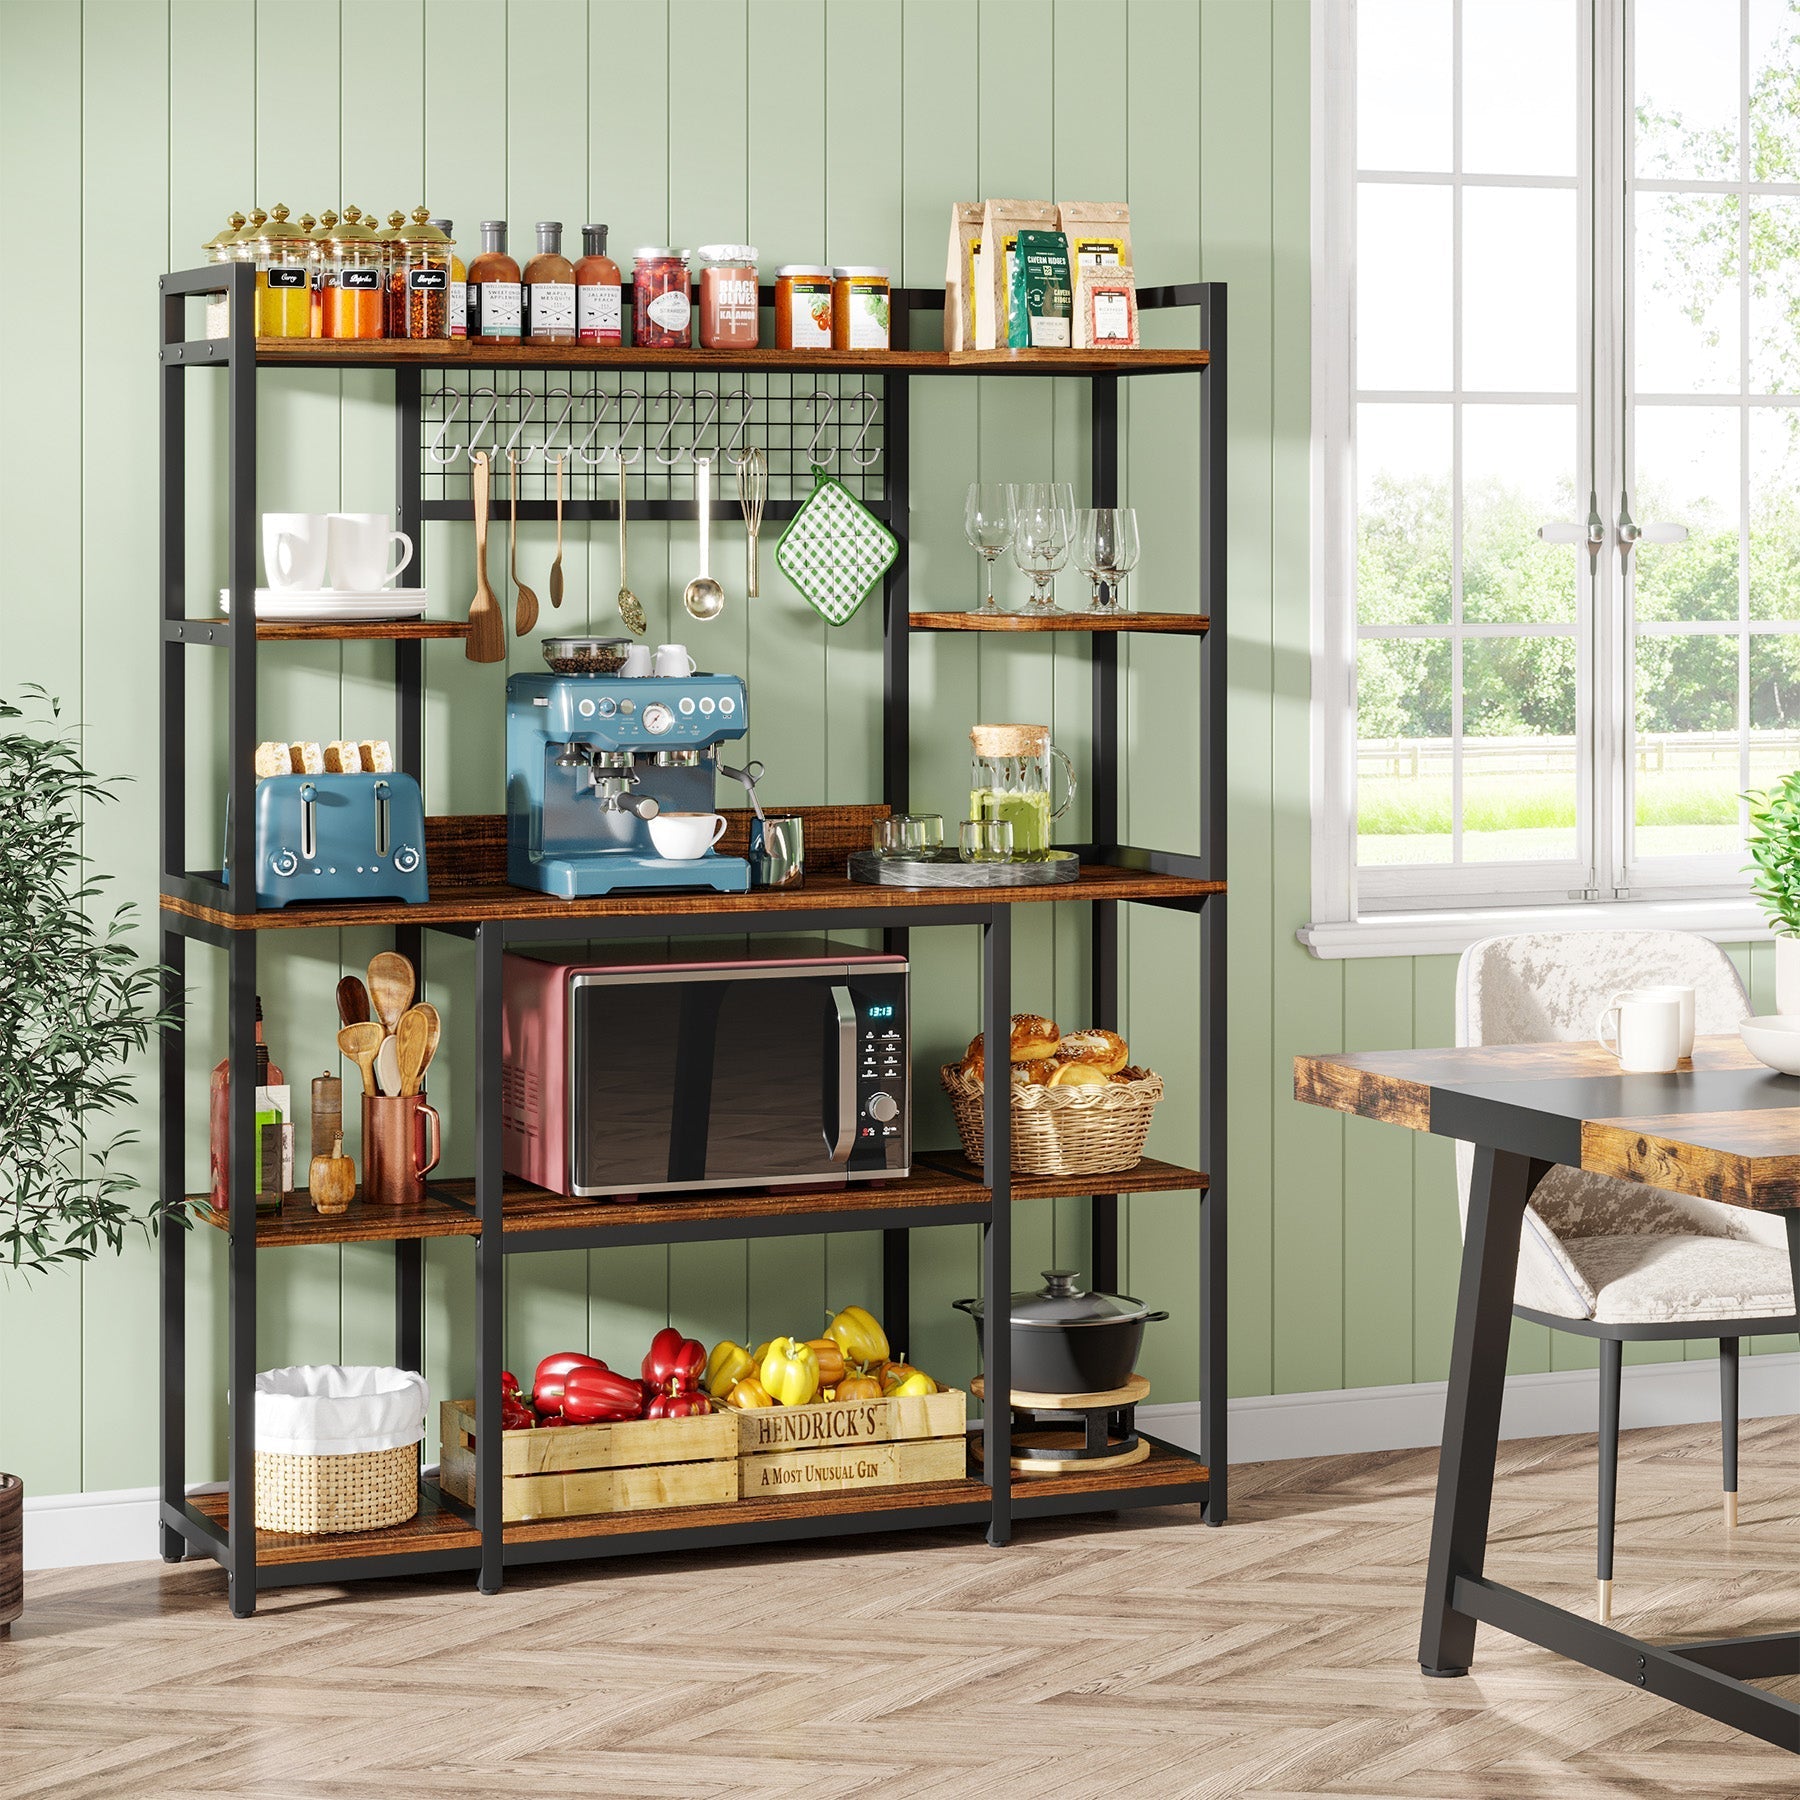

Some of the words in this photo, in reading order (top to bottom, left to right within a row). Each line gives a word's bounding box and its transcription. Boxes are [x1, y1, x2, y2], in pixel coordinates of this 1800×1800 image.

[719, 280, 756, 293] BLACK
[719, 292, 756, 305] OLIVES
[869, 1006, 893, 1017] 13:13
[758, 1407, 876, 1444] HENDRICK'S
[761, 1468, 770, 1486] A
